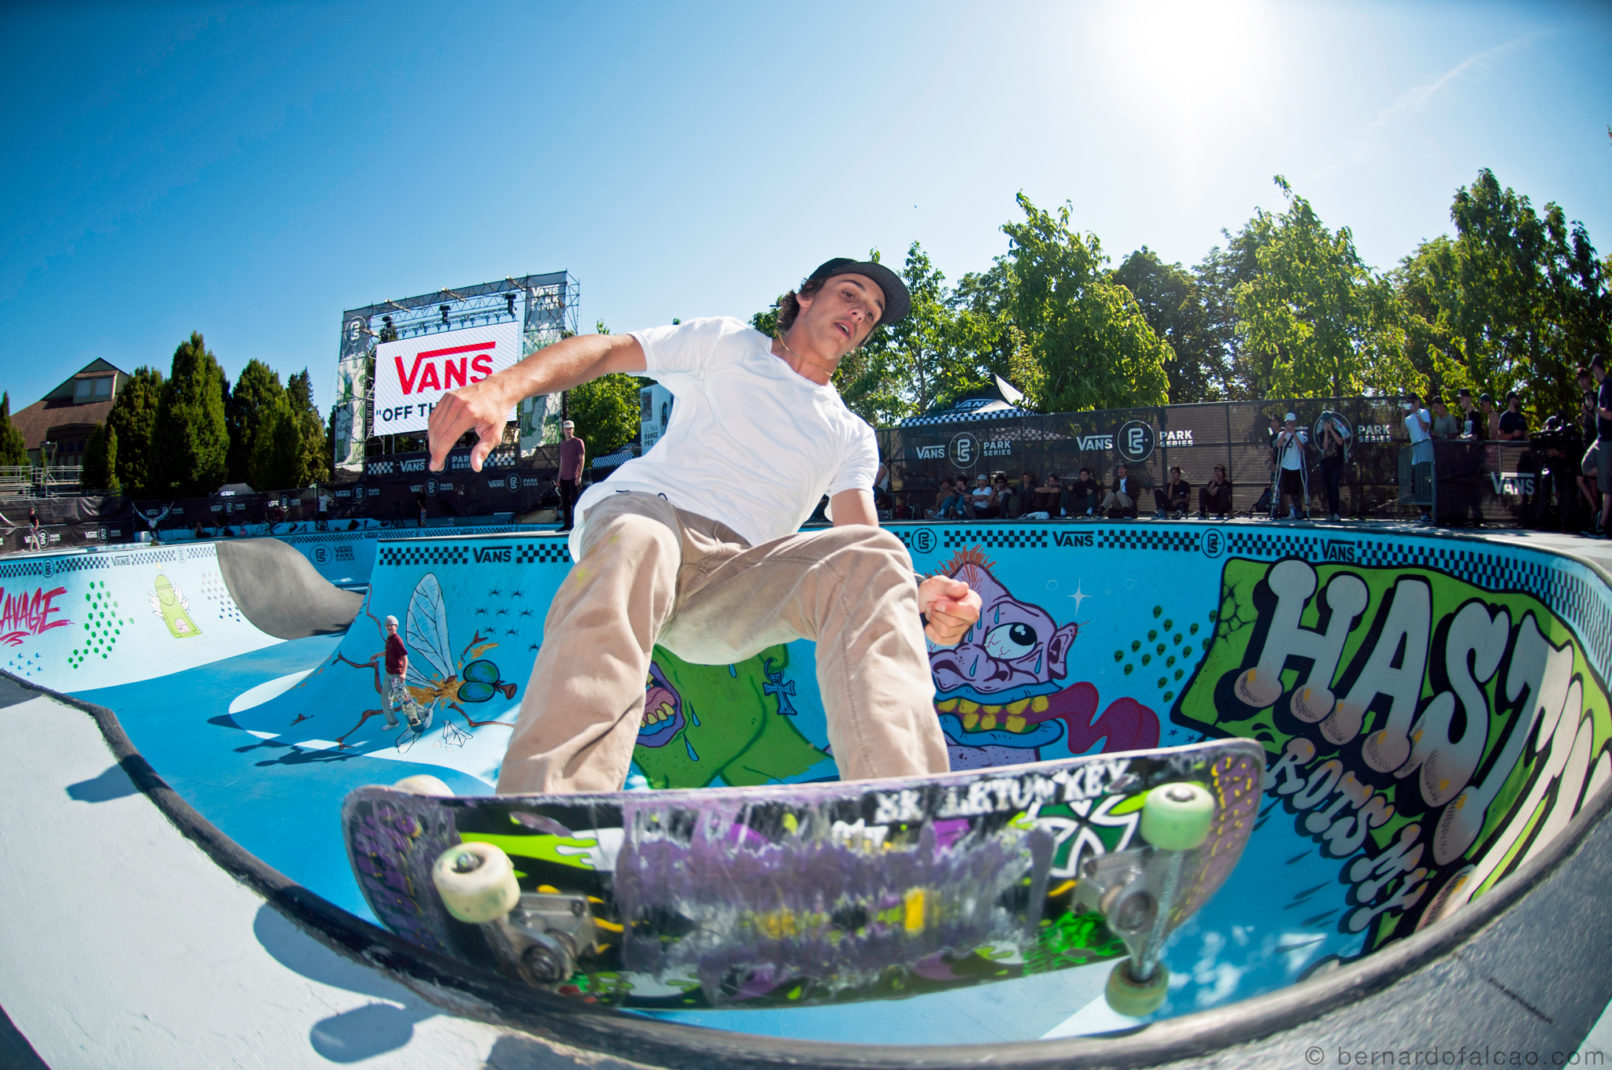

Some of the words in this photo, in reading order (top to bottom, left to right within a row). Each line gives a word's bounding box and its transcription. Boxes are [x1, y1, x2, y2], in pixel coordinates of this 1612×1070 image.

[532, 283, 560, 297] VANS
[394, 341, 496, 395] VANS
[1159, 430, 1193, 441] PARK
[1358, 424, 1391, 435] PARK
[983, 441, 1012, 450] PARK
[1076, 434, 1113, 451] VANS
[1159, 440, 1194, 448] SERIES
[1358, 435, 1392, 443] SERIES
[452, 455, 471, 463] PAR
[916, 445, 946, 459] VANS
[983, 449, 1012, 457] SERIES
[400, 459, 426, 473] VANS
[488, 480, 505, 488] VANS
[1490, 472, 1535, 496] VANS
[1052, 530, 1094, 547] VANS
[473, 546, 513, 563] VANS
[1320, 538, 1355, 561] VANS
[110, 555, 131, 567] VANS
[0, 586, 75, 636] AVAGE
